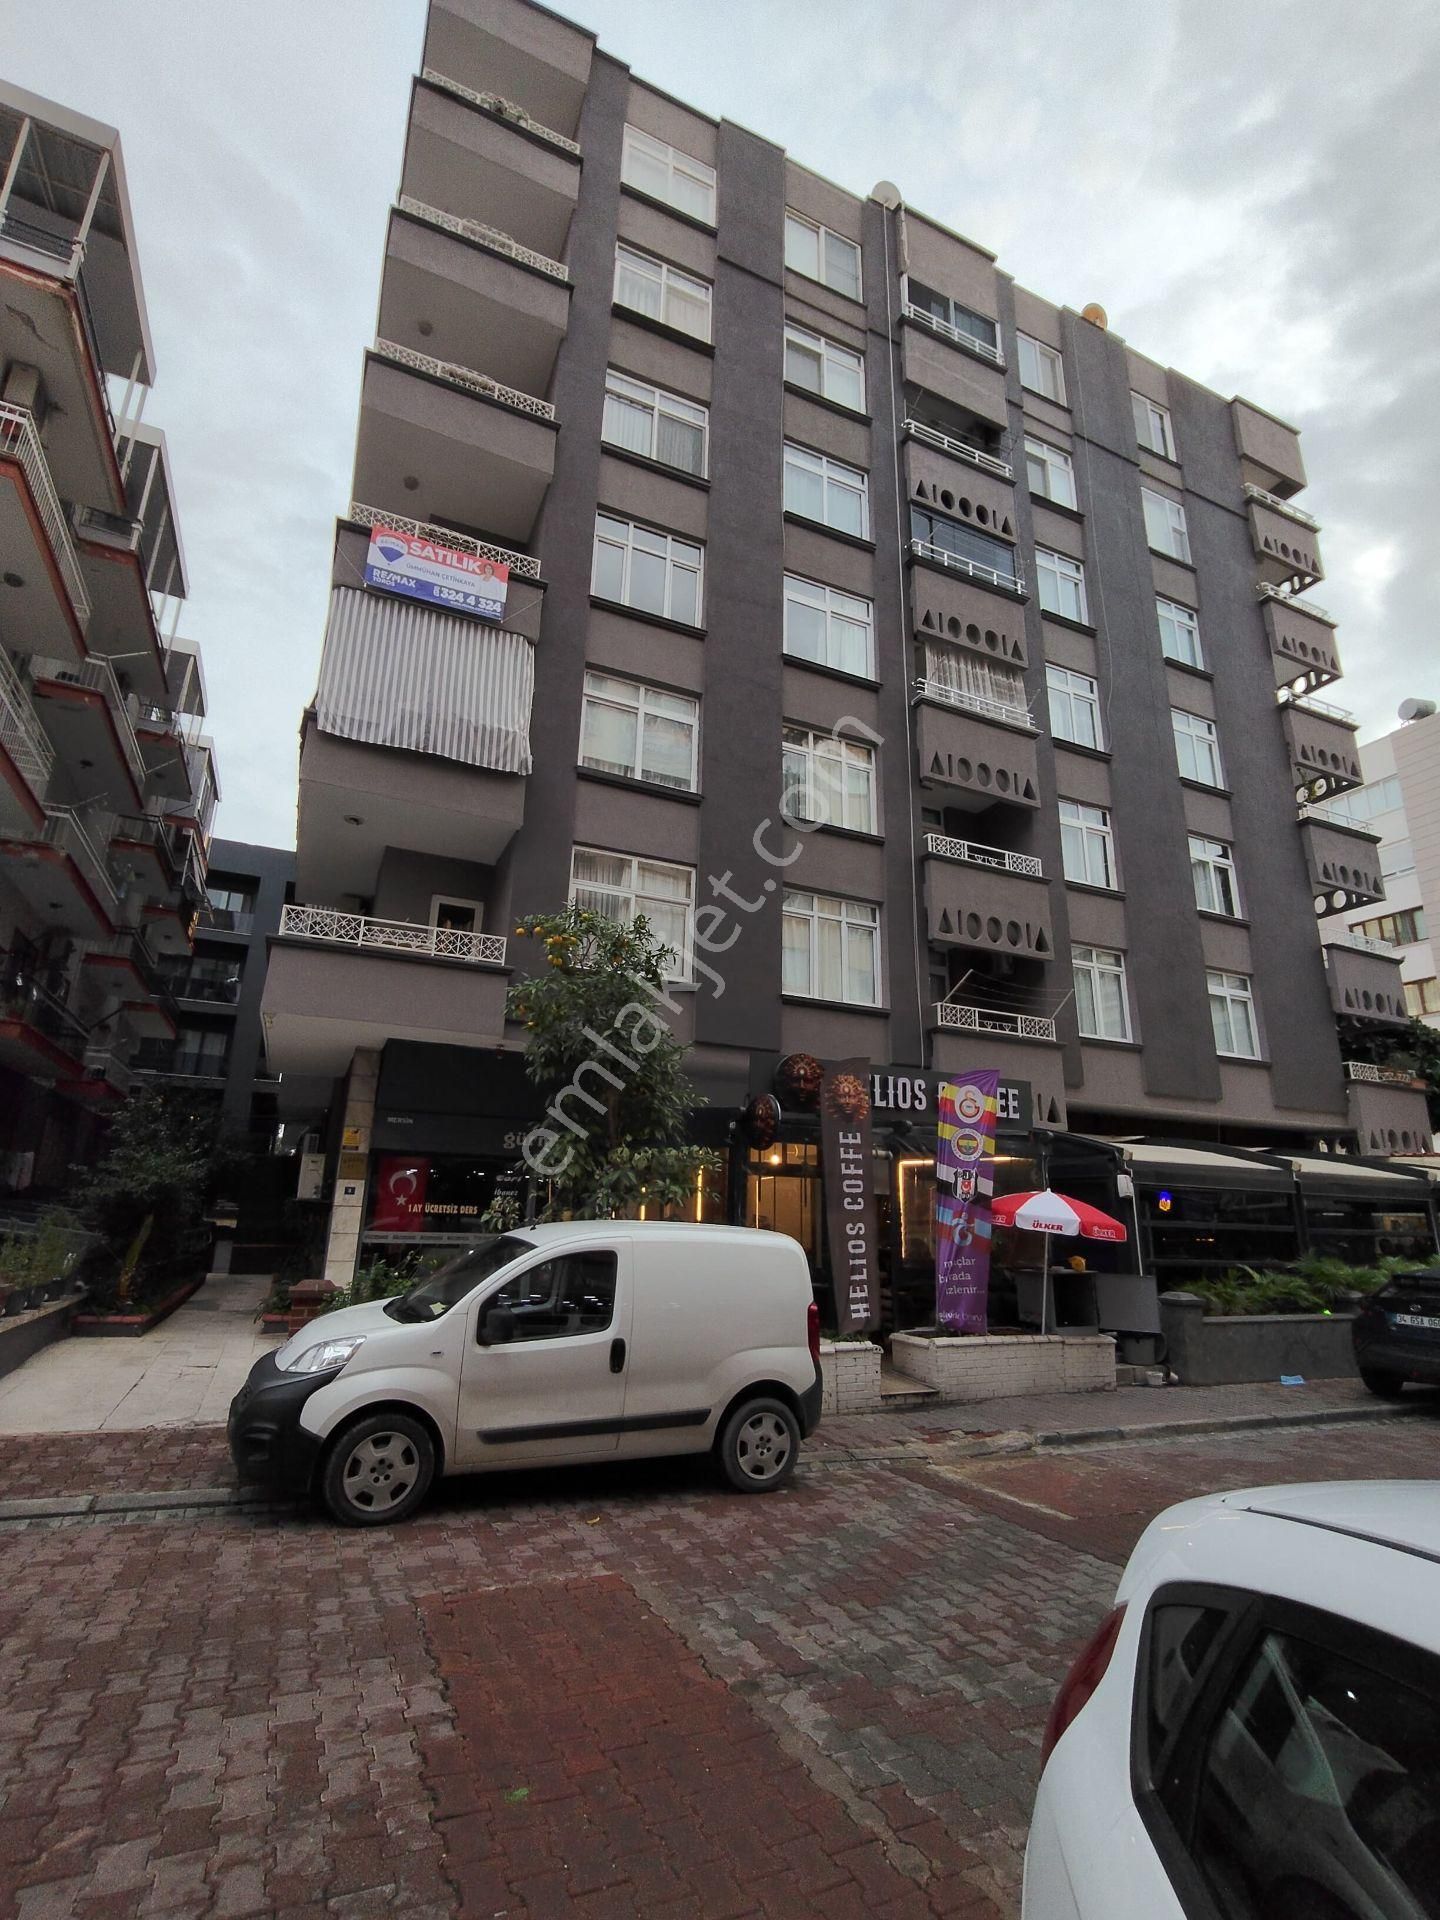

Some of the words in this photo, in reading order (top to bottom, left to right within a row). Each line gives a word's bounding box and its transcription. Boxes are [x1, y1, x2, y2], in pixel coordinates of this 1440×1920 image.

[410, 541, 482, 574] SATILIK
[373, 568, 416, 588] RE/MAX
[441, 587, 464, 603] 324
[466, 595, 476, 606] 4
[478, 598, 501, 613] 324
[869, 1074, 926, 1111] LIOS
[839, 1131, 865, 1211] COFFE
[412, 1203, 423, 1213] AY
[425, 1202, 458, 1214] ÜCRETSİZ
[460, 1205, 478, 1215] DERS
[1032, 1219, 1063, 1232] ÜLKER
[846, 1222, 871, 1319] HELIOS
